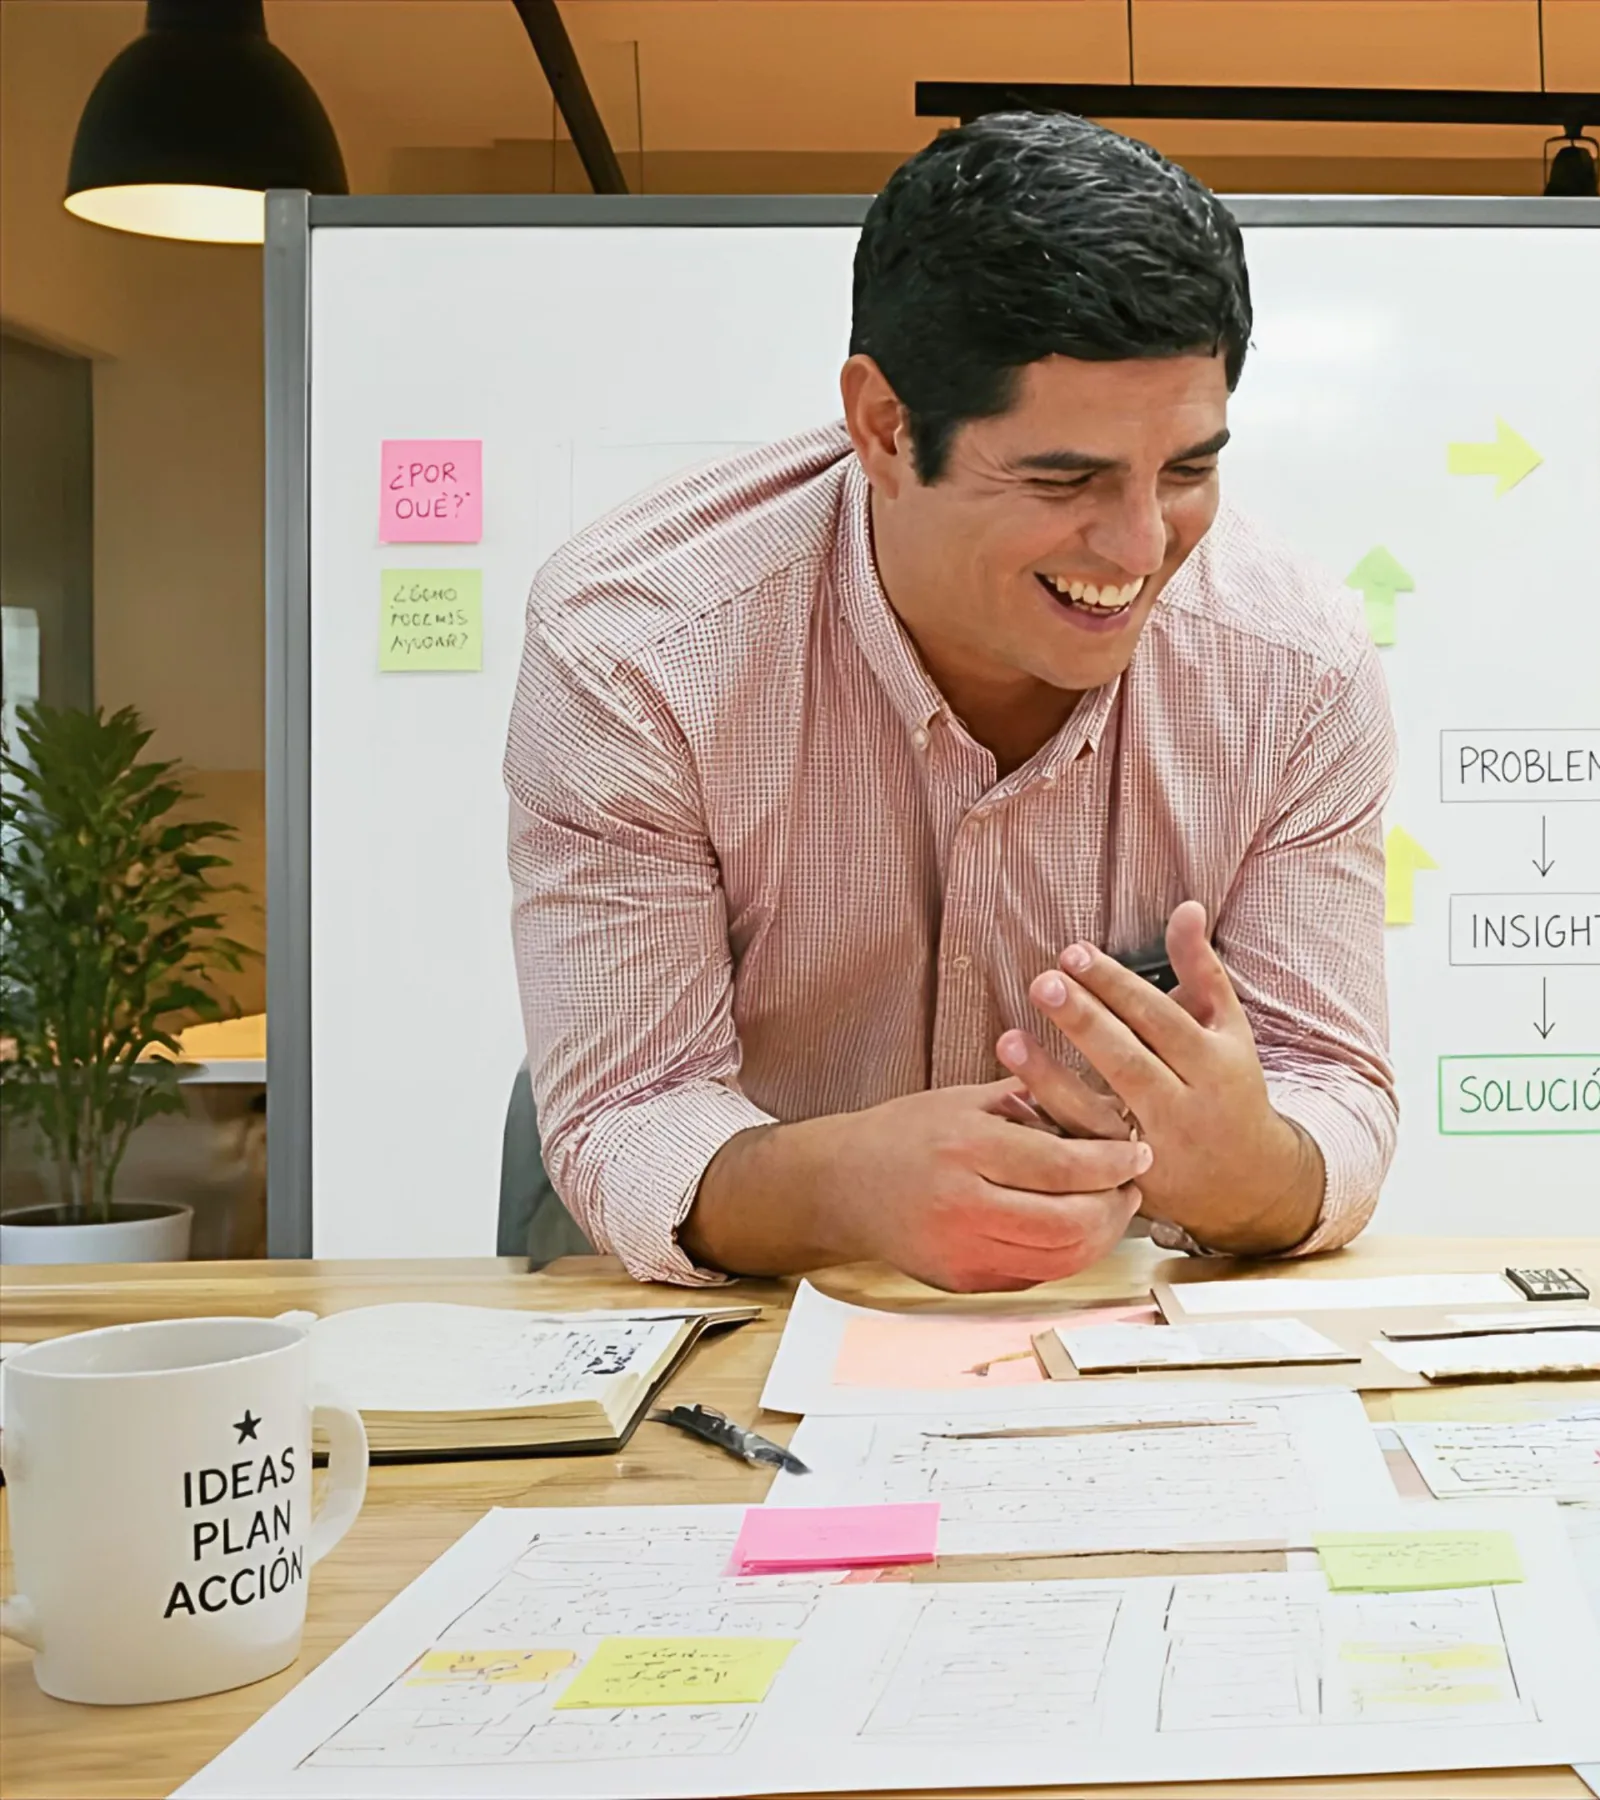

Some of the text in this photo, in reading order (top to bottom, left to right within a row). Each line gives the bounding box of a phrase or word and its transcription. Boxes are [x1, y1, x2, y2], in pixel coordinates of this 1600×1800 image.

[389, 461, 458, 491] ¿POR
[183, 1446, 296, 1508] IDEAS
[193, 1500, 292, 1562] PLAN
[162, 1545, 304, 1619] ACCIÓN
